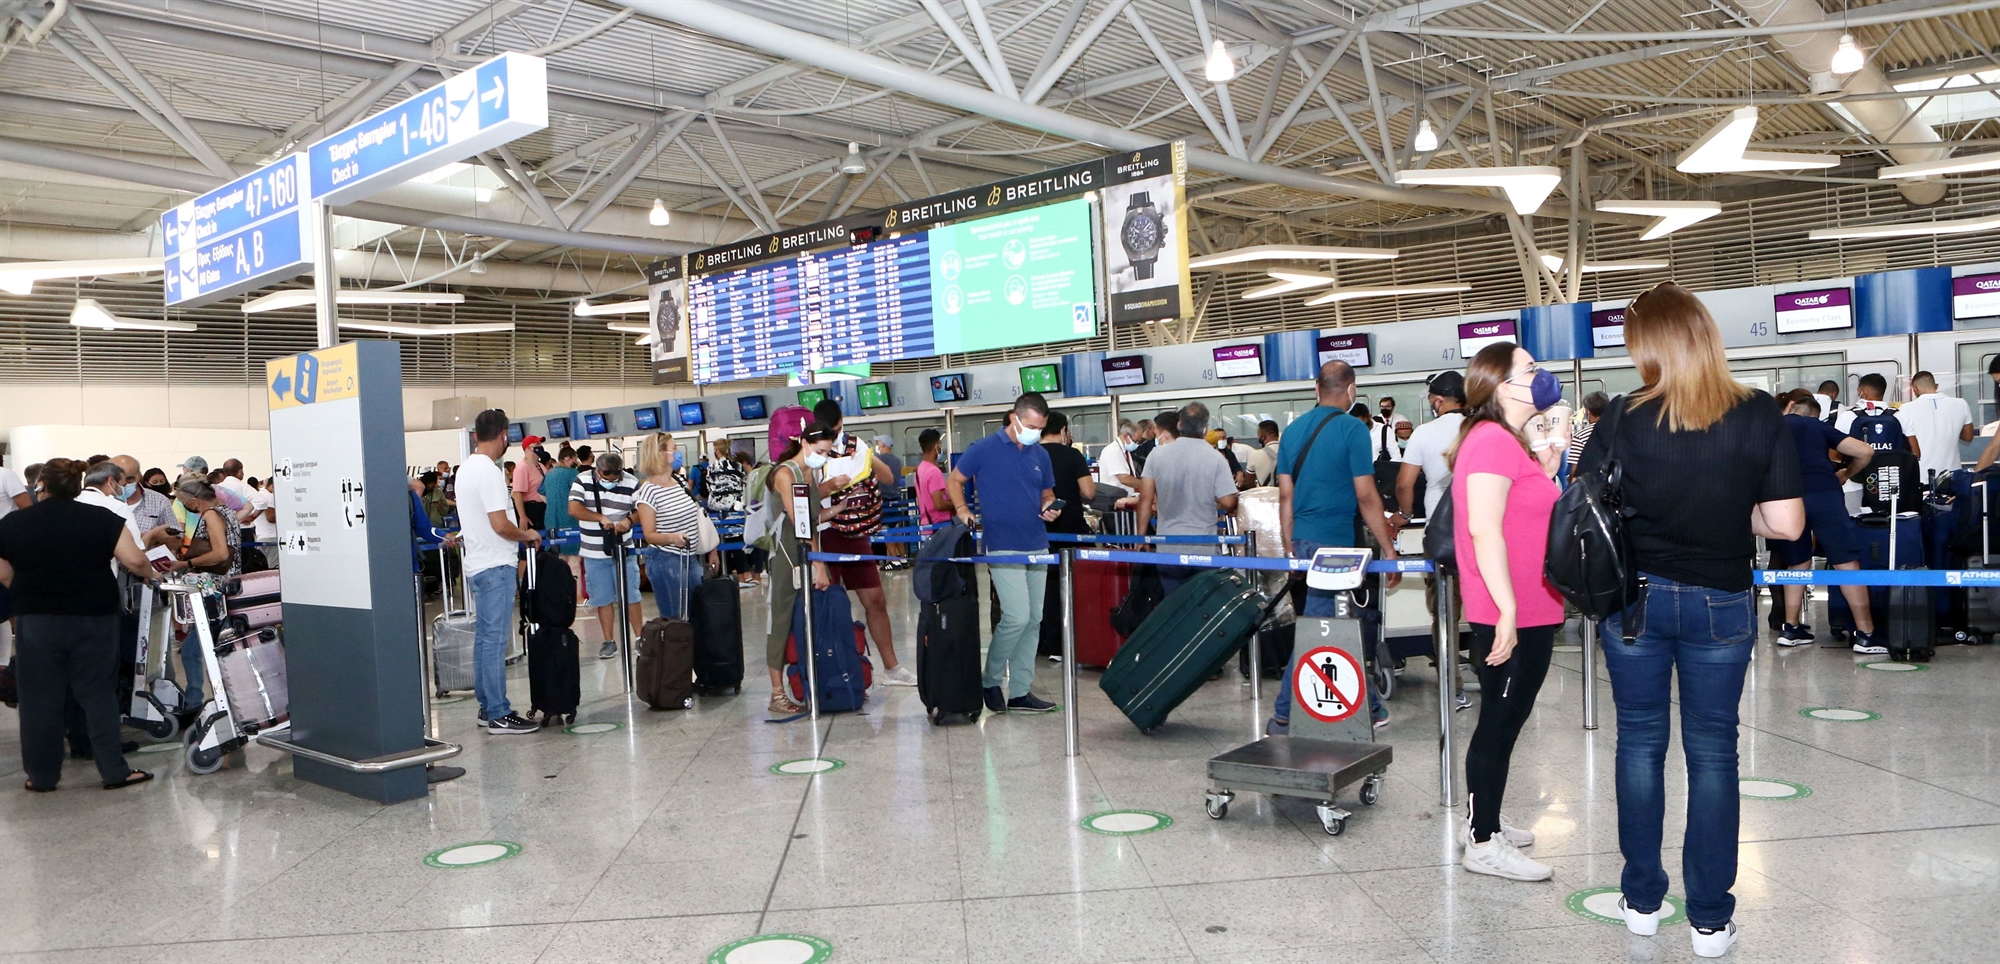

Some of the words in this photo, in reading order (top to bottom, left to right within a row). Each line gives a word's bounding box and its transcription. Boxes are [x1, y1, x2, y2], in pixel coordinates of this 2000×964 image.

[400, 96, 446, 156] 1-46
[331, 163, 352, 186] Check
[351, 160, 359, 177] in
[1116, 158, 1160, 175] BREITLING
[245, 164, 296, 219] 47-160
[1006, 170, 1093, 201] BREITLING
[901, 195, 977, 224] BREITLING
[196, 223, 212, 240] Check
[211, 220, 218, 234] in
[782, 224, 845, 250] BREITLING
[253, 230, 265, 268] B
[707, 243, 762, 267] BREITLING
[1124, 298, 1168, 311] #SQUADONAMISSION
[1795, 297, 1818, 306] QATAR
[1607, 314, 1625, 323] QATA
[1822, 314, 1842, 322] Class
[1473, 326, 1492, 335] QATAR
[1750, 322, 1768, 337] 45
[1330, 340, 1346, 348] QATAR
[1381, 353, 1394, 366] 48
[1442, 348, 1455, 361] 47
[1154, 373, 1165, 385] 50
[1202, 368, 1214, 381] 49
[323, 387, 343, 395] Information
[973, 389, 983, 400] 52
[1012, 386, 1021, 397] 51
[897, 397, 905, 407] 53
[1878, 466, 1889, 481] TEAM
[1878, 481, 1890, 501] HELLAS
[1338, 603, 1348, 616] 5
[1320, 620, 1330, 637] 5
